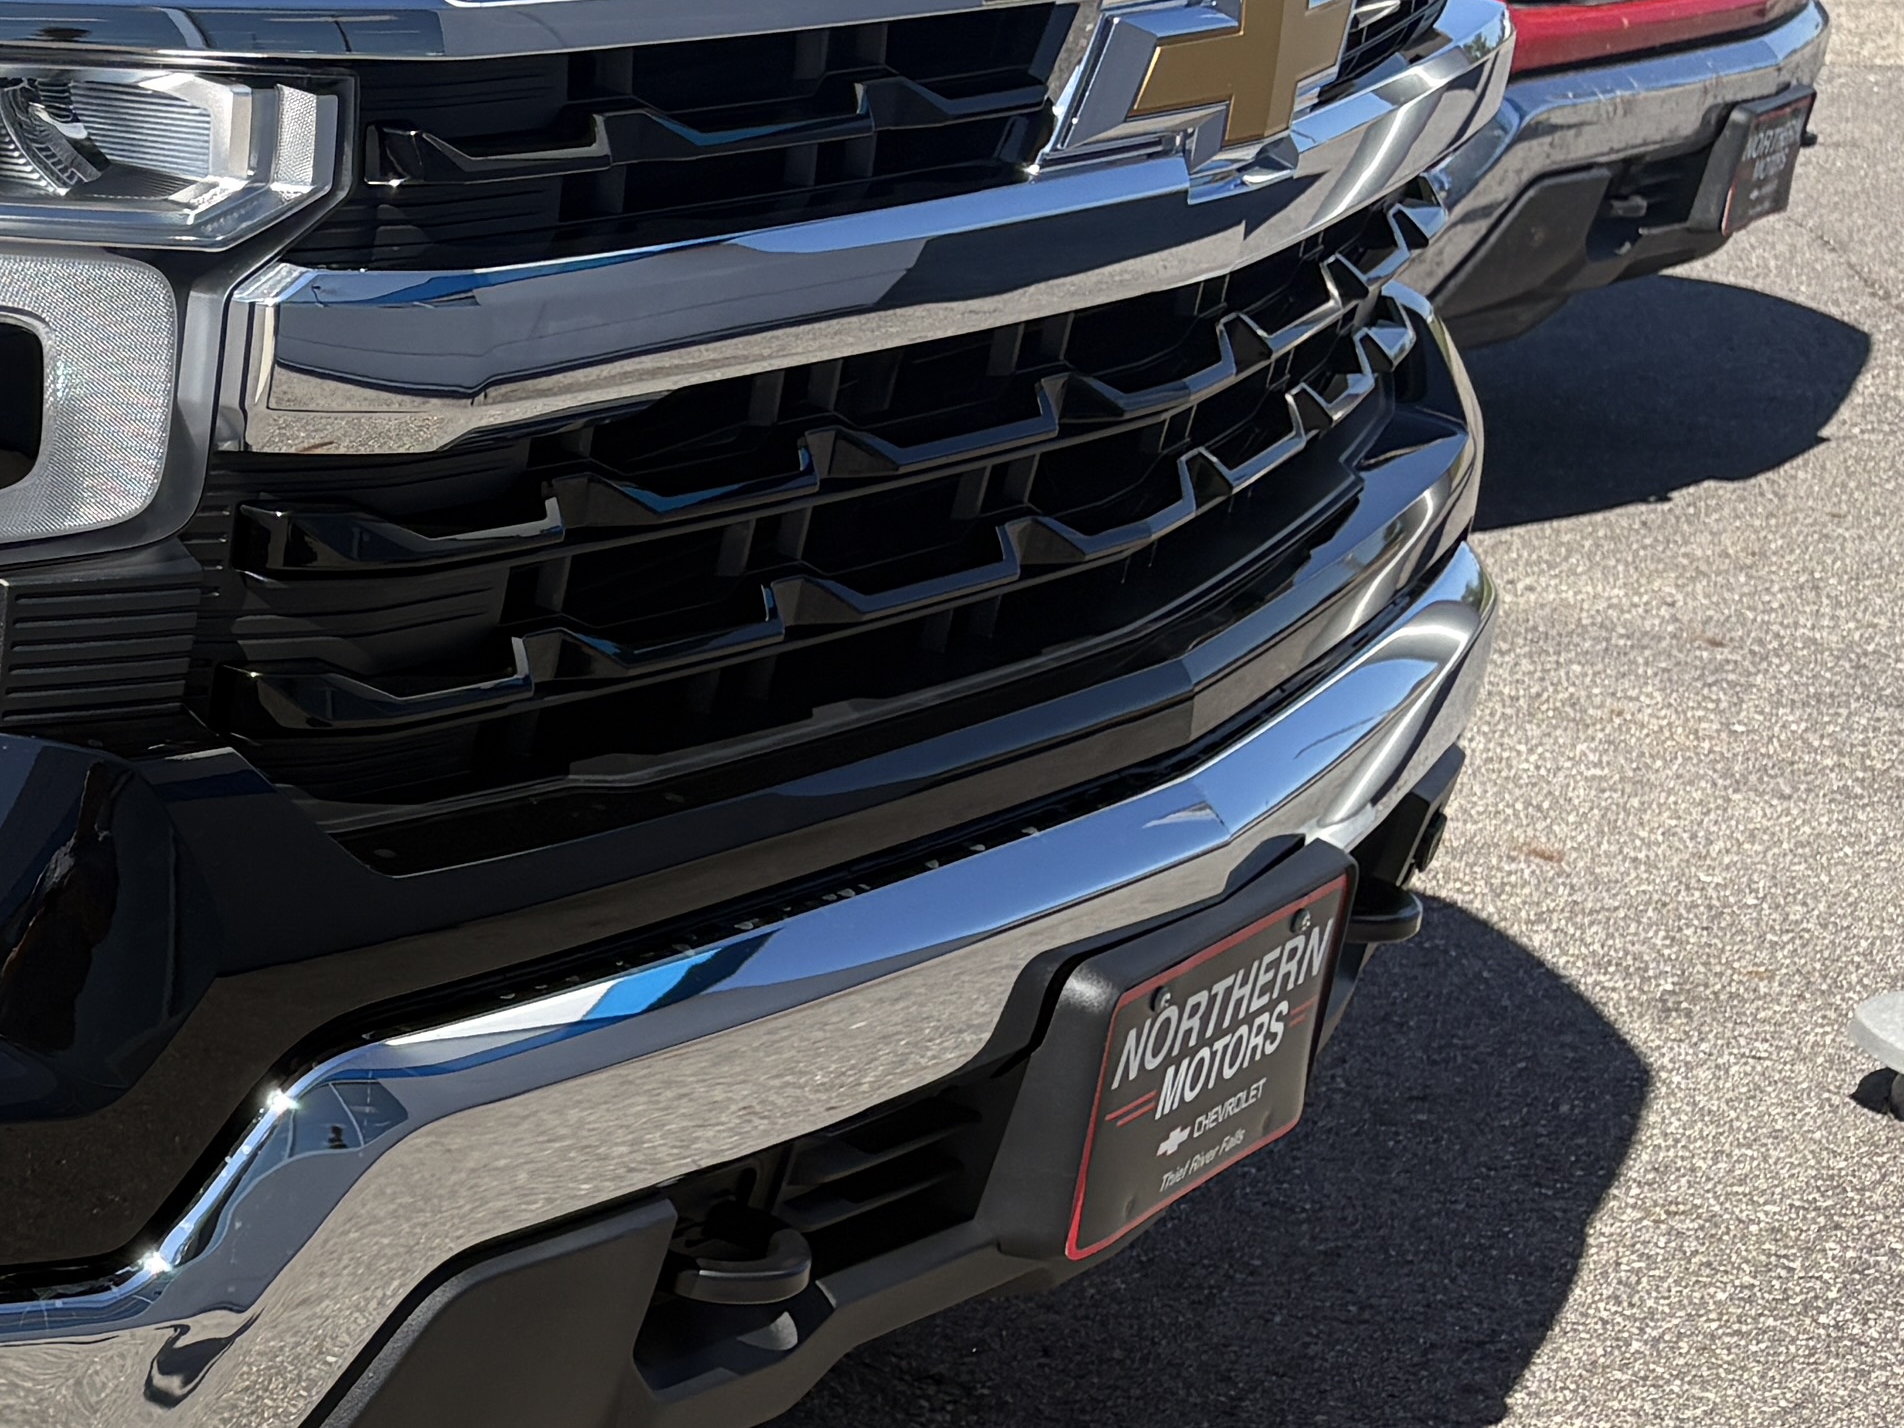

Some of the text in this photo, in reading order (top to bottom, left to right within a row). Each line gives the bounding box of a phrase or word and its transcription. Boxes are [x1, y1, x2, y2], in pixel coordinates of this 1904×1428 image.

[1111, 917, 1333, 1090] NORTHERN
[1154, 1000, 1290, 1120] MOTORS
[1193, 1077, 1267, 1138] CHEVROLET
[1159, 1159, 1191, 1192] Thief
[1189, 1145, 1220, 1175] River
